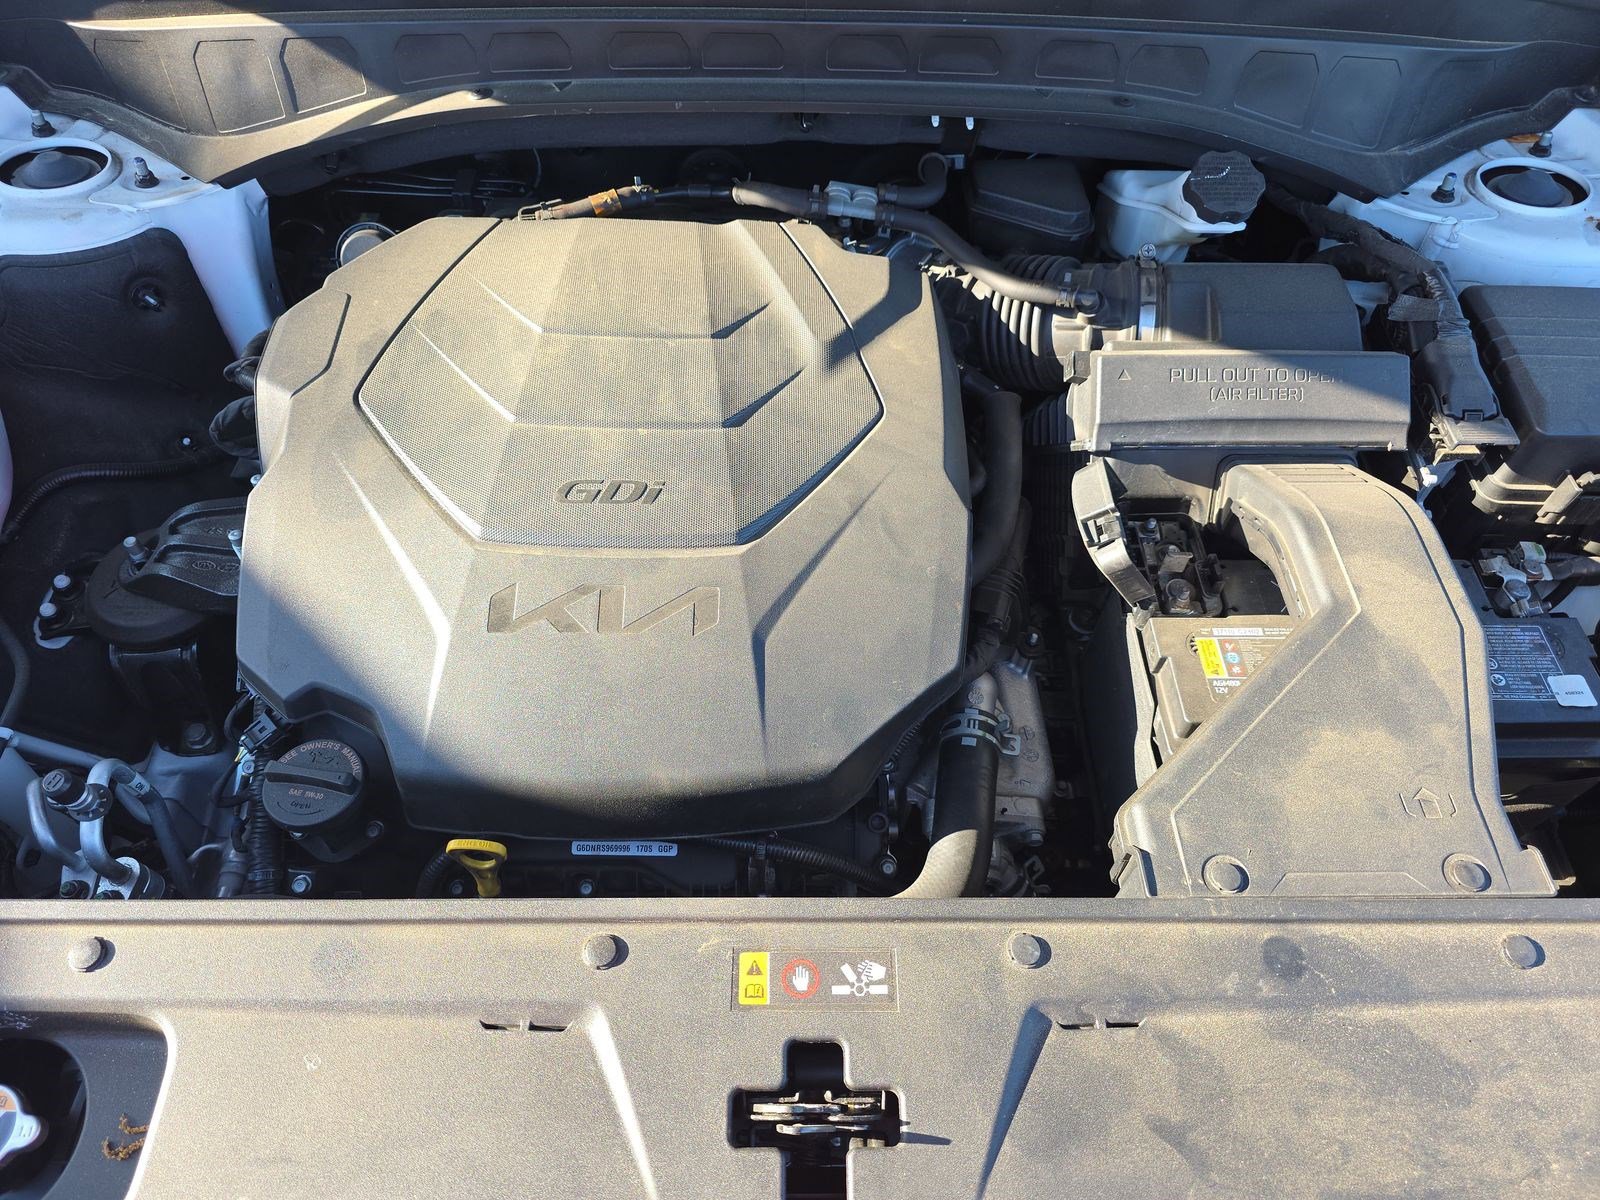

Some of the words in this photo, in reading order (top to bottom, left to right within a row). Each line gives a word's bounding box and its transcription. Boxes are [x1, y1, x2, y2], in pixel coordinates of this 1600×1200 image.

[1169, 367, 1217, 383] PULL
[1221, 367, 1259, 383] OUT
[1264, 367, 1289, 383] TO
[1209, 387, 1242, 402] (AIR
[1246, 387, 1304, 402] FILTER)
[554, 479, 666, 504] GDi
[487, 582, 720, 636] KIA
[280, 749, 299, 764] SEE
[300, 740, 341, 752] OWNER'S
[341, 747, 361, 776] MANUAL
[288, 788, 302, 797] SAE
[290, 800, 311, 809] OPEN
[657, 845, 674, 853] GGP
